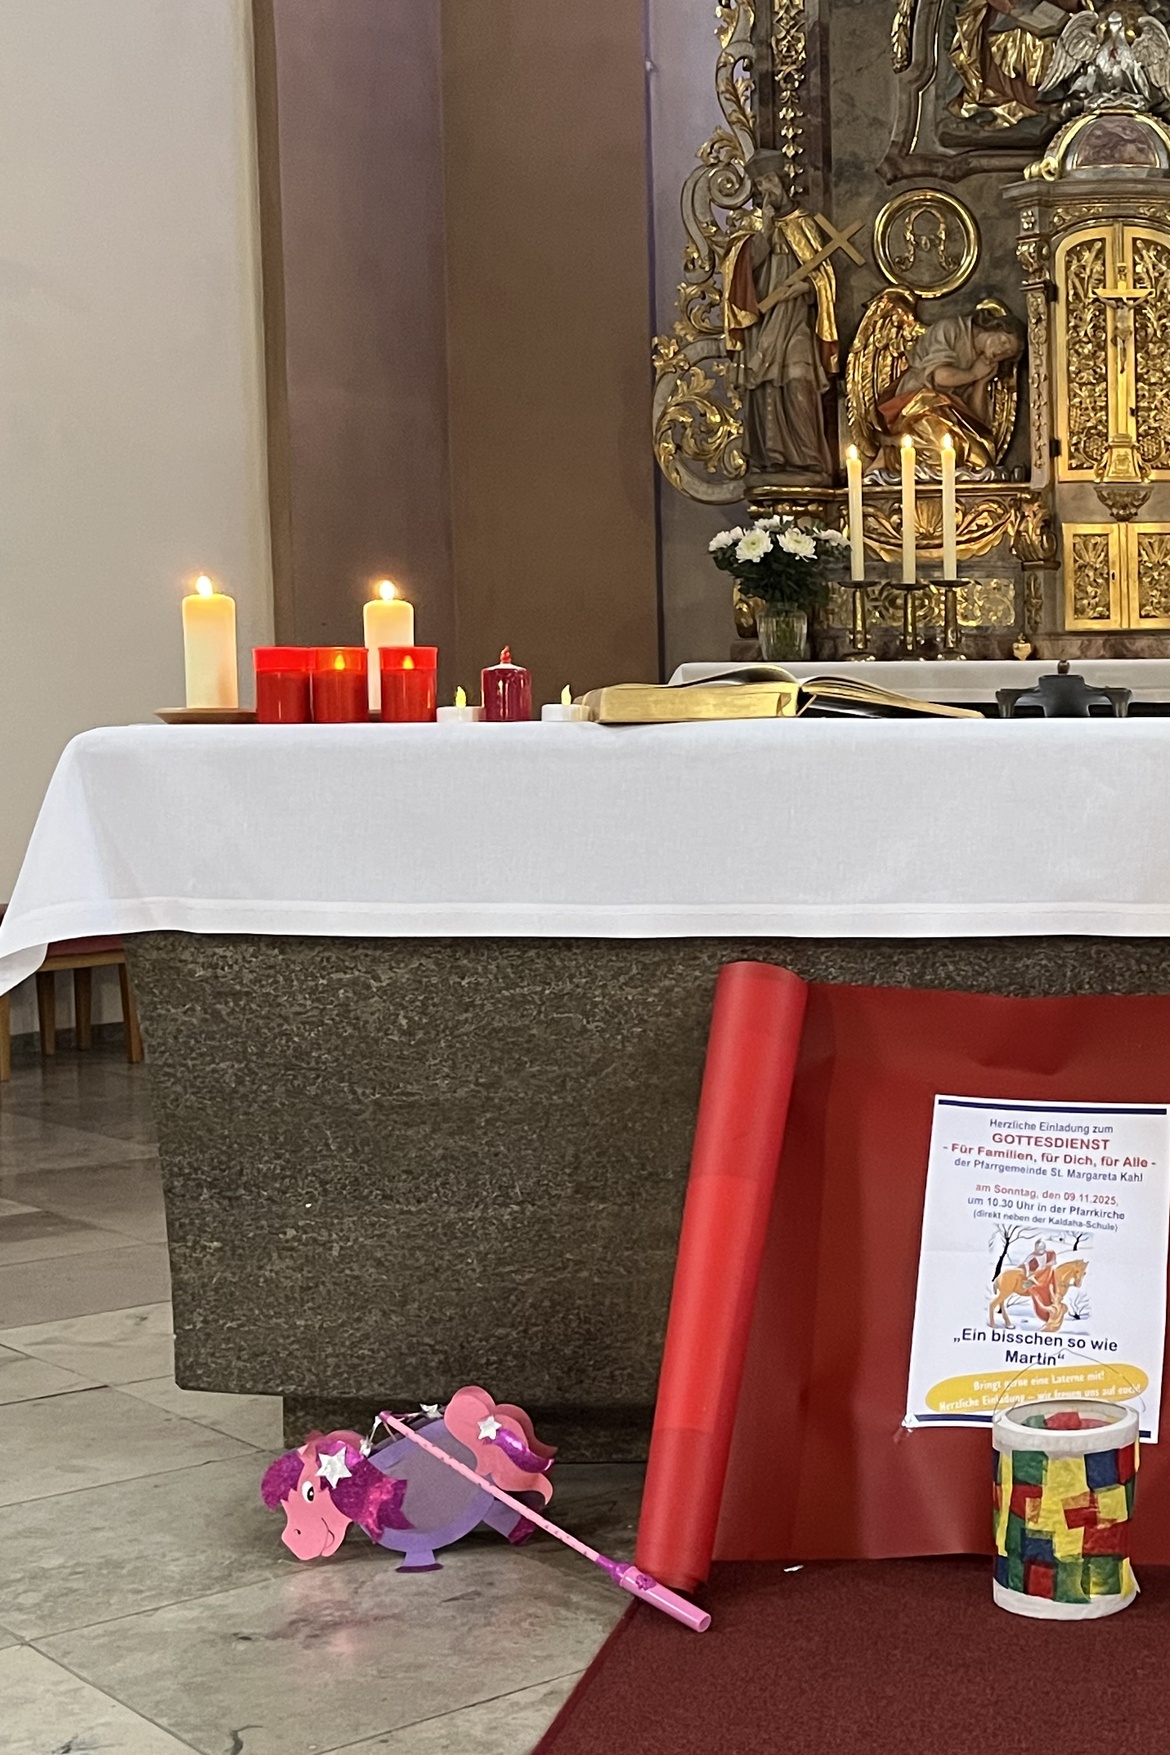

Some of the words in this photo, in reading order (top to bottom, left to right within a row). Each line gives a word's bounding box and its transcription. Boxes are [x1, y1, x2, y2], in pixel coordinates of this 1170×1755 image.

[990, 1119, 1036, 1131] Herzliche
[1039, 1122, 1090, 1135] Einladung
[992, 1133, 1110, 1150] GOTTESDIENST
[951, 1144, 973, 1155] Für
[977, 1147, 1037, 1162] Familien,
[1041, 1153, 1060, 1163] für
[1064, 1155, 1097, 1166] Dich,
[1101, 1156, 1119, 1167] für
[1123, 1157, 1148, 1167] Alle
[954, 1158, 970, 1167] der
[973, 1160, 1048, 1176] Pfarrgemeinde
[1067, 1170, 1118, 1182] Margareta
[1121, 1172, 1143, 1182] Kahl
[1042, 1191, 1060, 1200] den
[973, 1210, 1001, 1220] (direkt
[1003, 1213, 1030, 1222] neben
[1032, 1214, 1046, 1223] der
[987, 1198, 1013, 1209] 10.30
[1016, 1200, 1034, 1211] Uhr
[1037, 1203, 1047, 1212] in
[1050, 1204, 1066, 1214] der
[1069, 1206, 1125, 1220] Pfarrkirche
[954, 1328, 986, 1343] „Ein
[992, 1332, 1063, 1347] bisschen
[1067, 1338, 1086, 1348] so
[1091, 1339, 1118, 1351] wie
[1005, 1350, 1065, 1366] Martin“
[973, 1379, 1001, 1392] Bringt
[1004, 1378, 1028, 1389] gerne
[1031, 1375, 1049, 1385] eine
[1052, 1372, 1084, 1384] Laterne
[1087, 1371, 1105, 1381] mit!
[939, 1398, 979, 1411] Herzliche
[982, 1395, 1025, 1405] Einladung
[1085, 1388, 1099, 1397] uns
[1102, 1385, 1116, 1396] auf
